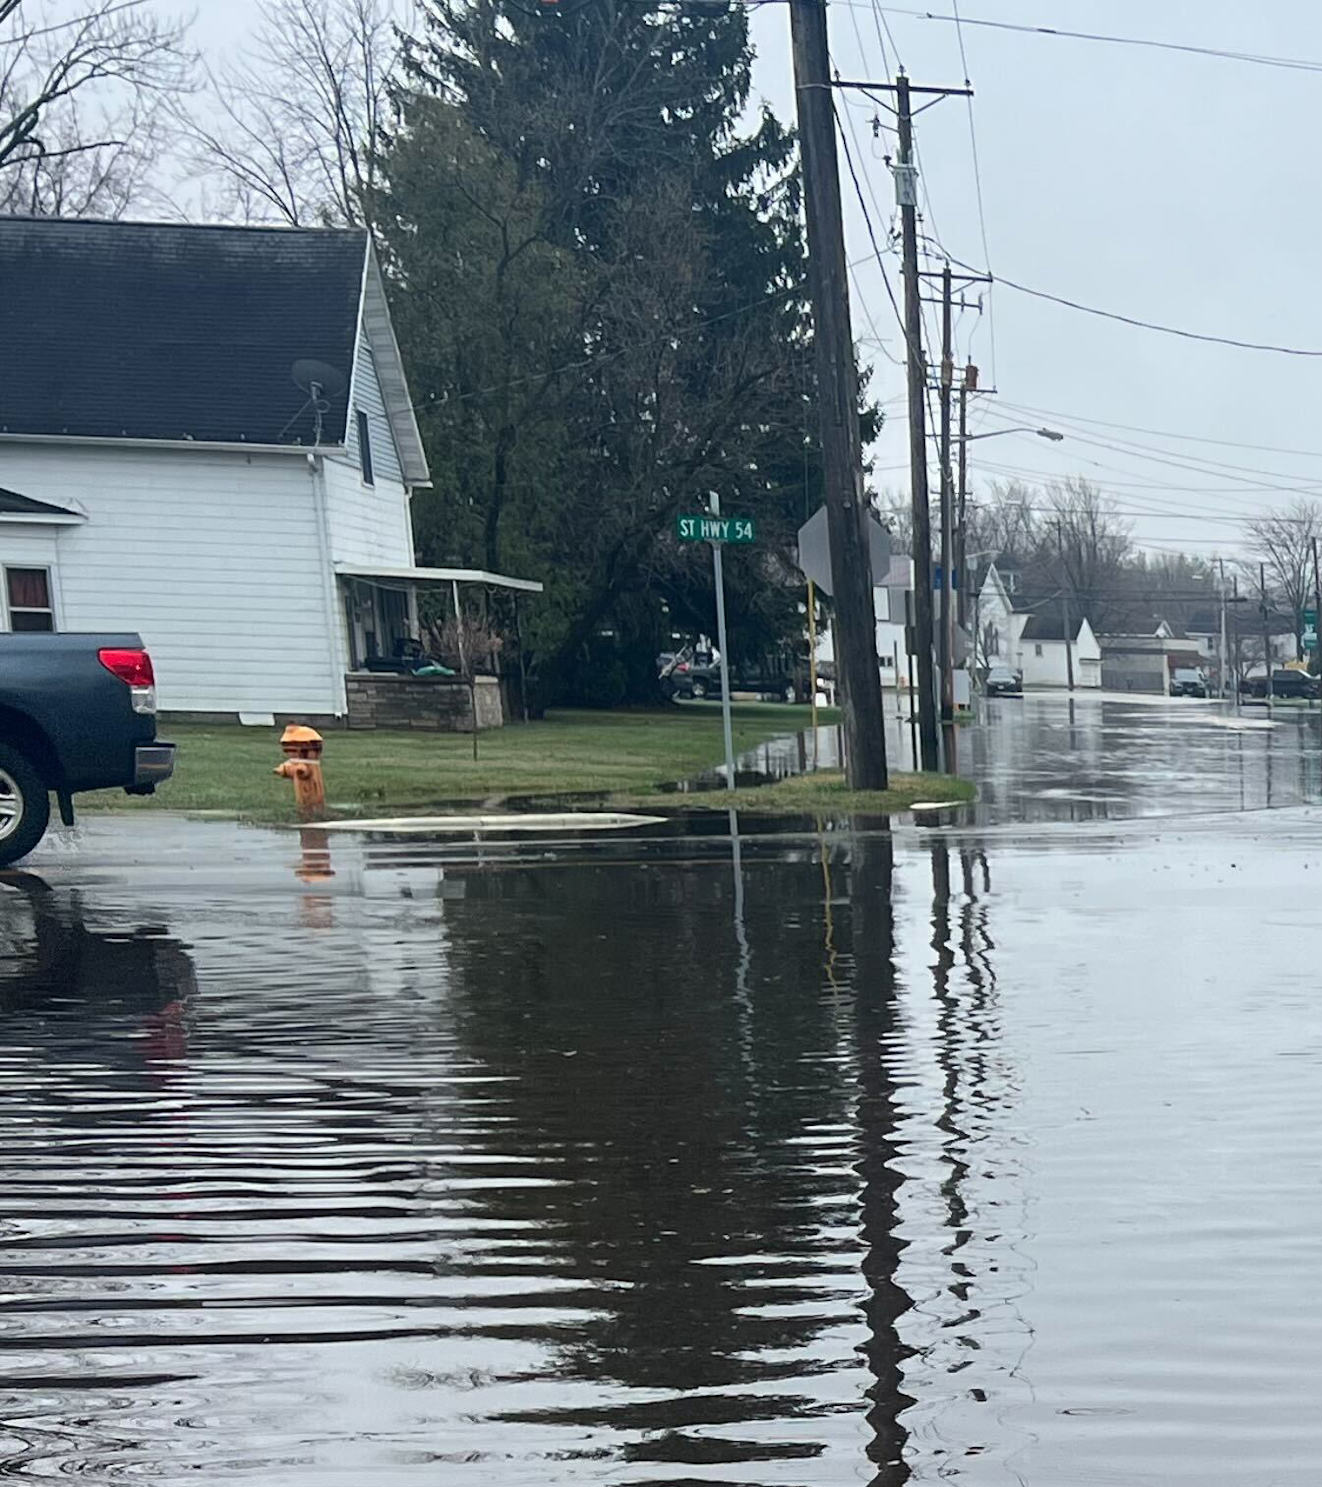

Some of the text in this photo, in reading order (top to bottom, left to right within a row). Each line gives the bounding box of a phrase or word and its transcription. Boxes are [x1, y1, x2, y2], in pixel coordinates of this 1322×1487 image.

[680, 519, 752, 539] ST HWY 54
